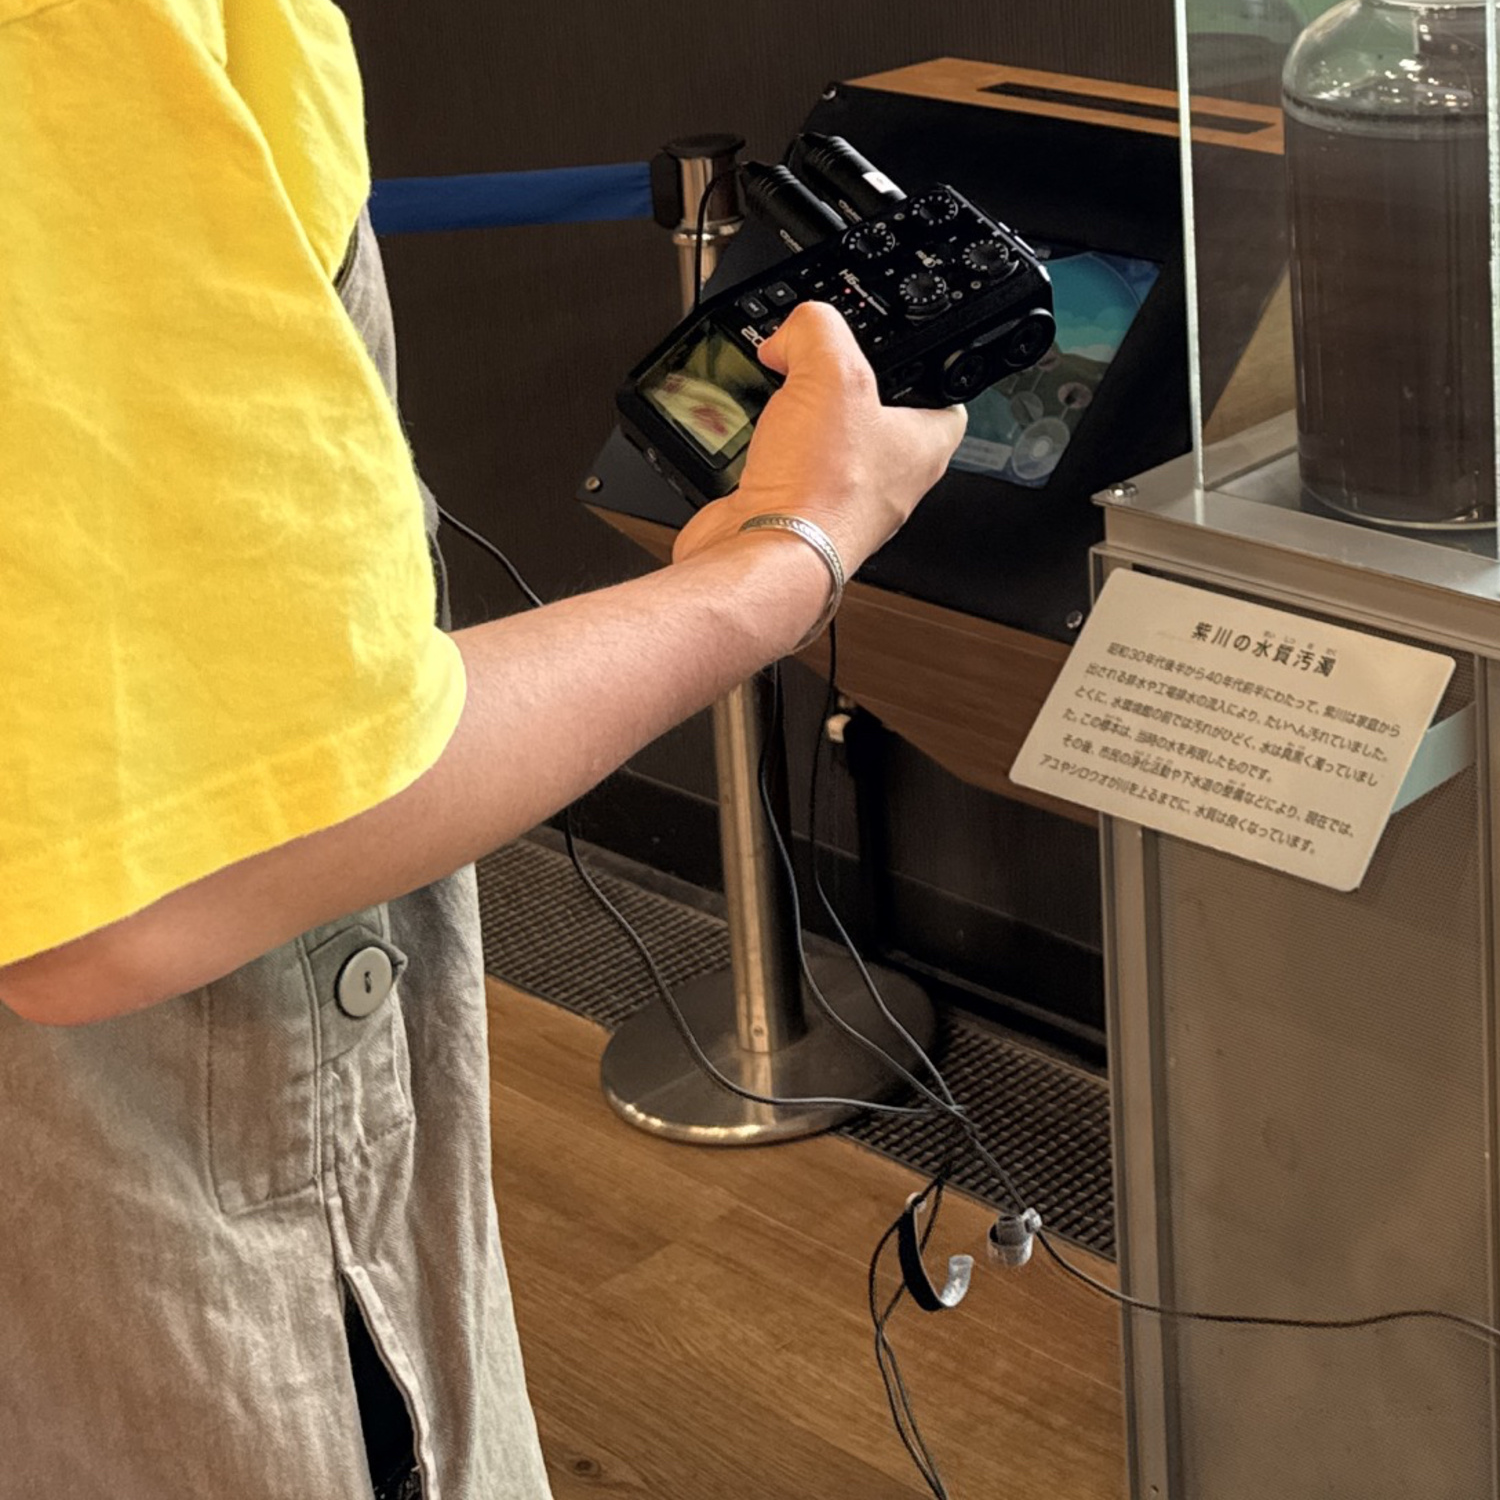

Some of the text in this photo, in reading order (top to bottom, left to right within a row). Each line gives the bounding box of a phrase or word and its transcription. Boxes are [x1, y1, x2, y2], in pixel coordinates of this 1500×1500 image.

[1189, 620, 1337, 677] 紫川の水質汚濁
